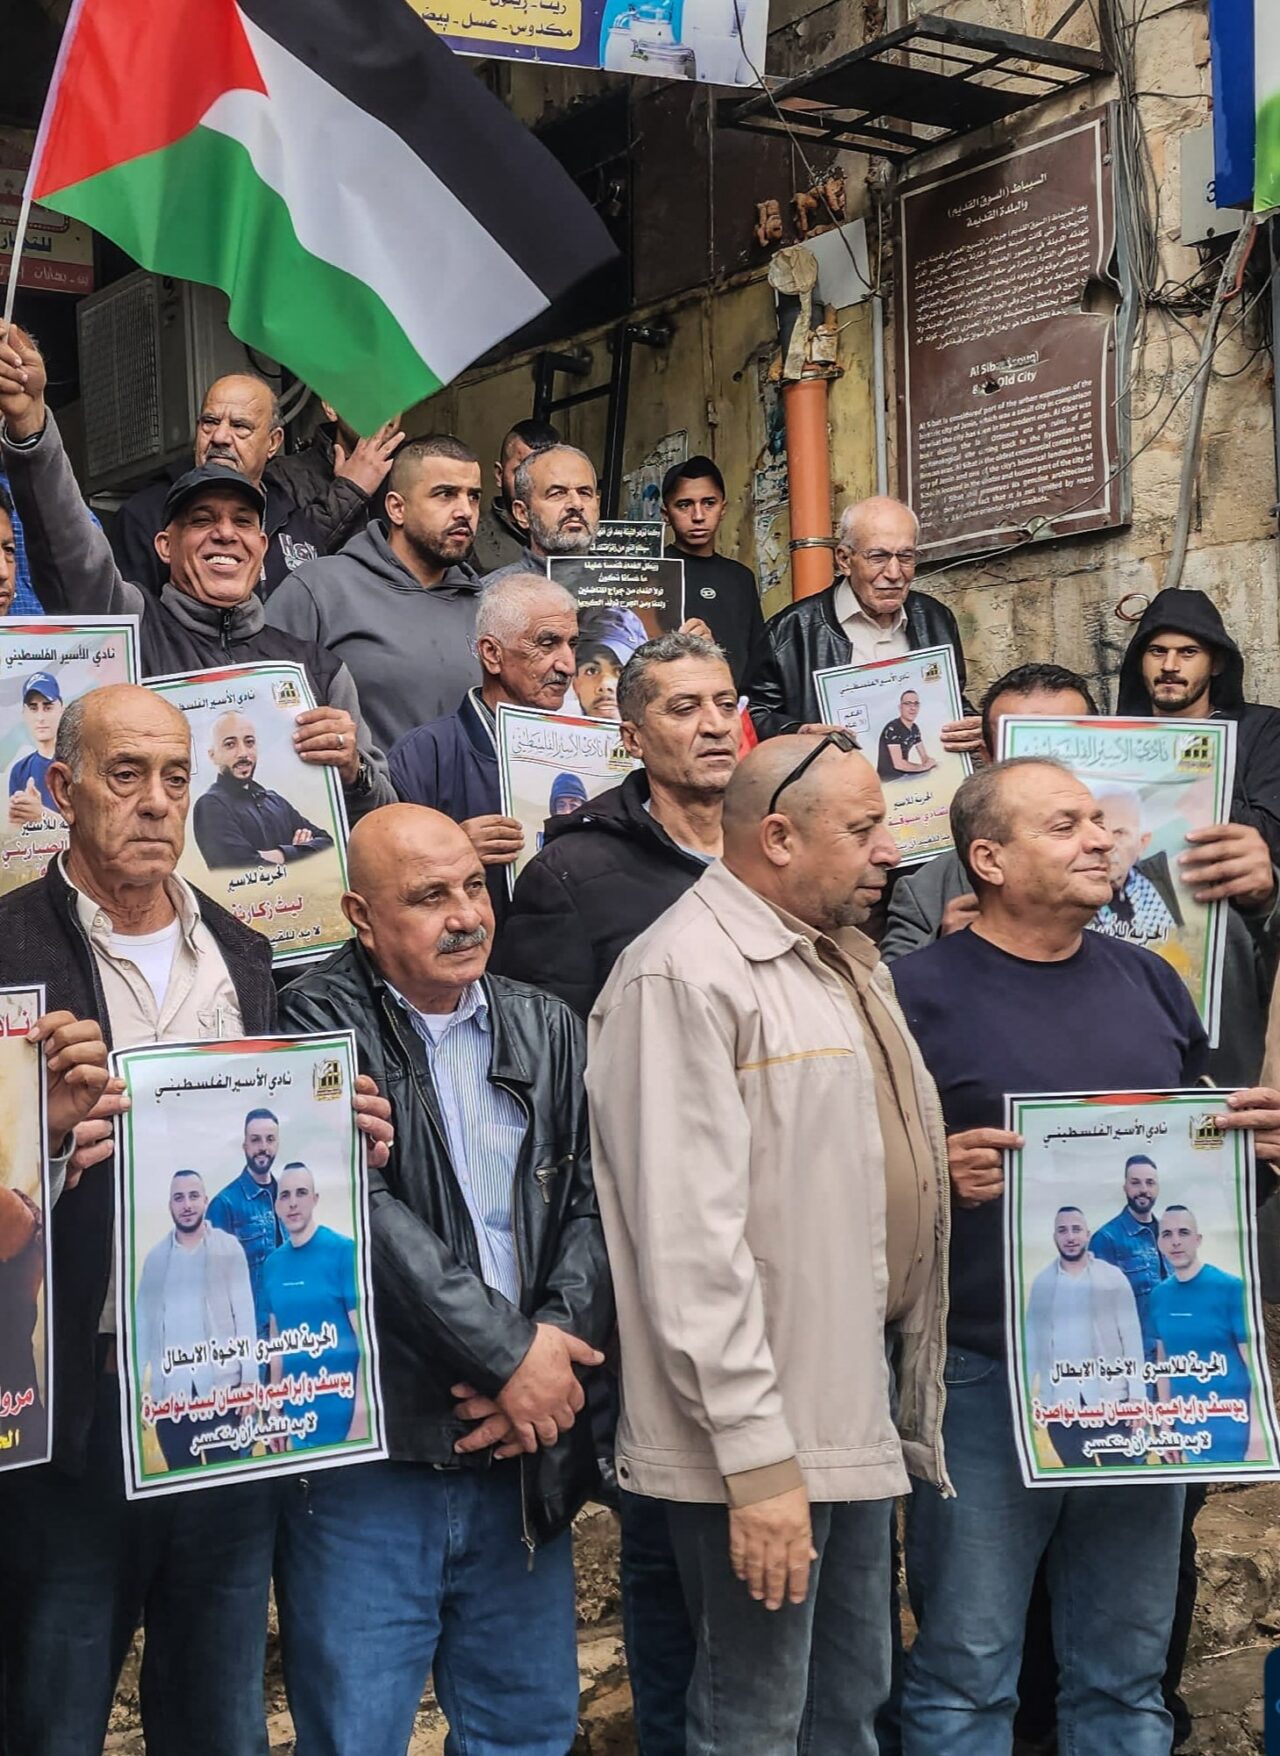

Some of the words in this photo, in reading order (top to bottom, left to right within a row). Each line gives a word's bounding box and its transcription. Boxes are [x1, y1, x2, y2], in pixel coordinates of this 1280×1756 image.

[461, 12, 498, 29] عسل
[510, 22, 573, 37] مكدوس
[969, 365, 980, 377] Al
[997, 374, 1016, 387] Old
[1017, 371, 1037, 382] City
[5, 649, 57, 669] الفلسطيني
[60, 645, 89, 665] الأسير
[93, 648, 115, 667] نادي
[209, 689, 236, 709] الأسير
[237, 689, 255, 709] نادي
[1135, 737, 1169, 762] نادي
[259, 866, 287, 886] الحرية
[275, 896, 303, 917] ليث
[270, 930, 295, 947] للقي
[298, 931, 311, 942] بد
[313, 926, 321, 935] لا
[155, 1073, 232, 1103] الفلسطيني
[232, 1068, 267, 1092] الأسير
[268, 1070, 292, 1095] نادي
[1043, 1123, 1113, 1148] الفلسطيني
[1113, 1119, 1145, 1140] الأسير
[1145, 1121, 1168, 1144] نادي
[301, 1324, 337, 1355] الحرية
[162, 1346, 207, 1373] الابطال
[212, 1340, 249, 1364] الاخوة
[1051, 1360, 1095, 1384] الابطال
[1099, 1358, 1137, 1382] الاخوة
[1190, 1351, 1227, 1382] الحرية
[316, 1369, 354, 1397] يوسف
[142, 1393, 186, 1423] نواصرة
[188, 1393, 217, 1421] لبيب
[1032, 1399, 1075, 1427] نواصرة
[1077, 1402, 1105, 1428] لبيب
[1206, 1393, 1247, 1421] يوسف
[255, 1418, 290, 1442] للقيد
[291, 1420, 307, 1438] بد
[306, 1413, 317, 1431] لا
[190, 1427, 240, 1455] ينكسر
[1082, 1435, 1132, 1457] ينكسر
[1147, 1434, 1181, 1455] للقيد
[1185, 1437, 1199, 1451] بد
[1199, 1432, 1211, 1447] لا
